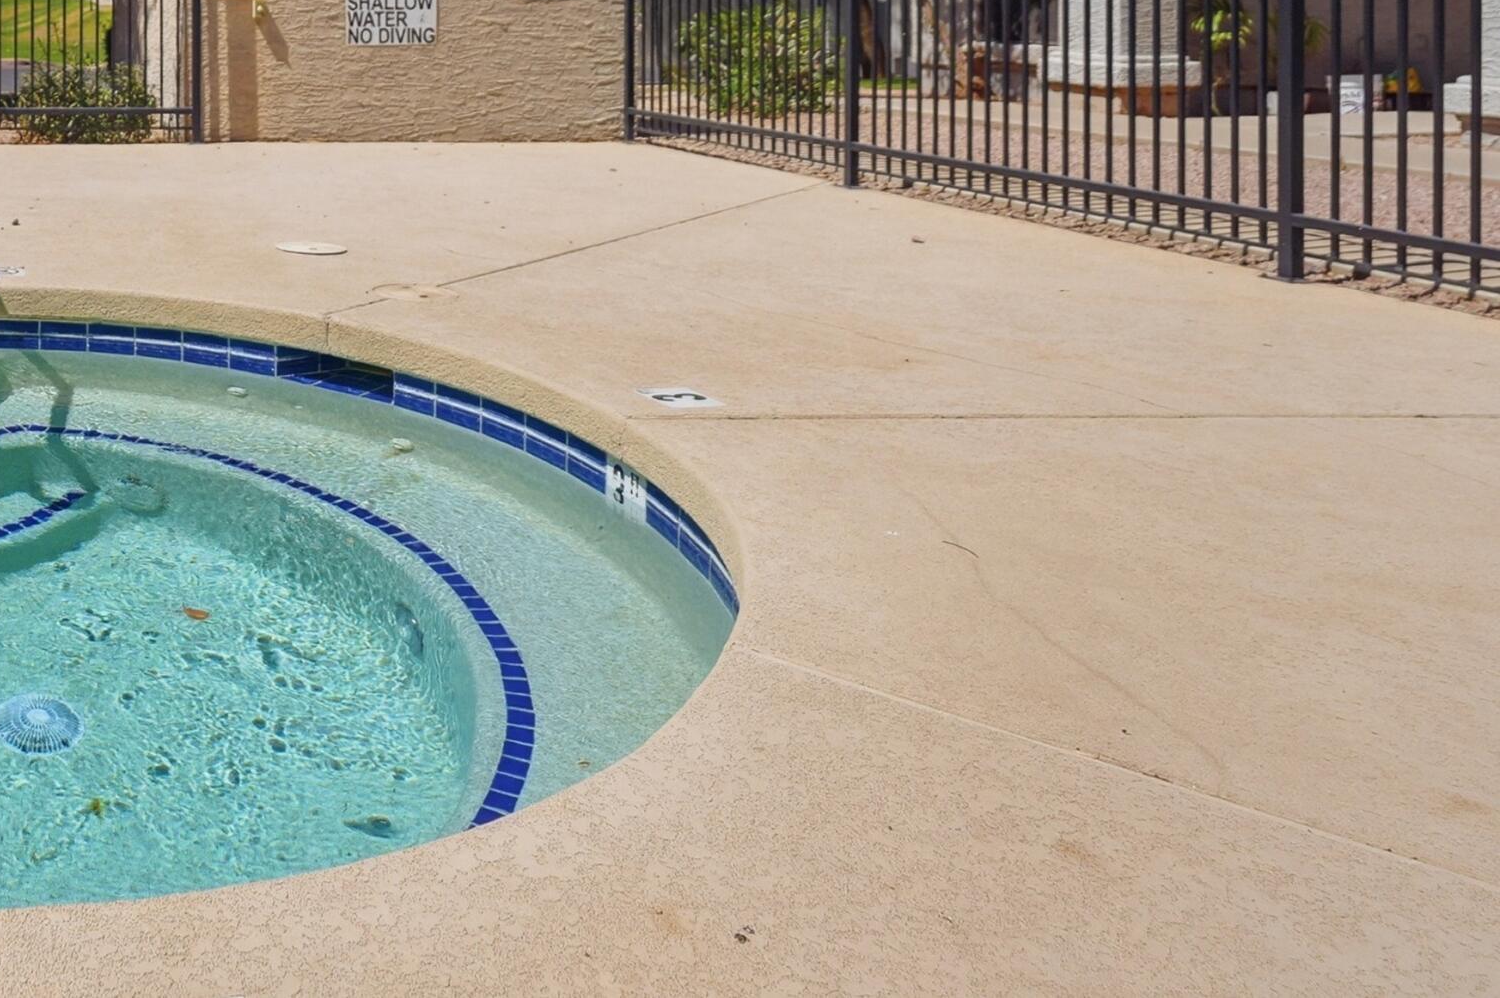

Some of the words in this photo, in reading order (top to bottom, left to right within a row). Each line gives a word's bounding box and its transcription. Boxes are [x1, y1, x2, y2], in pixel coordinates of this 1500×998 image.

[348, 11, 408, 27] WATER
[348, 28, 373, 45] NO
[379, 28, 436, 44] DIVING
